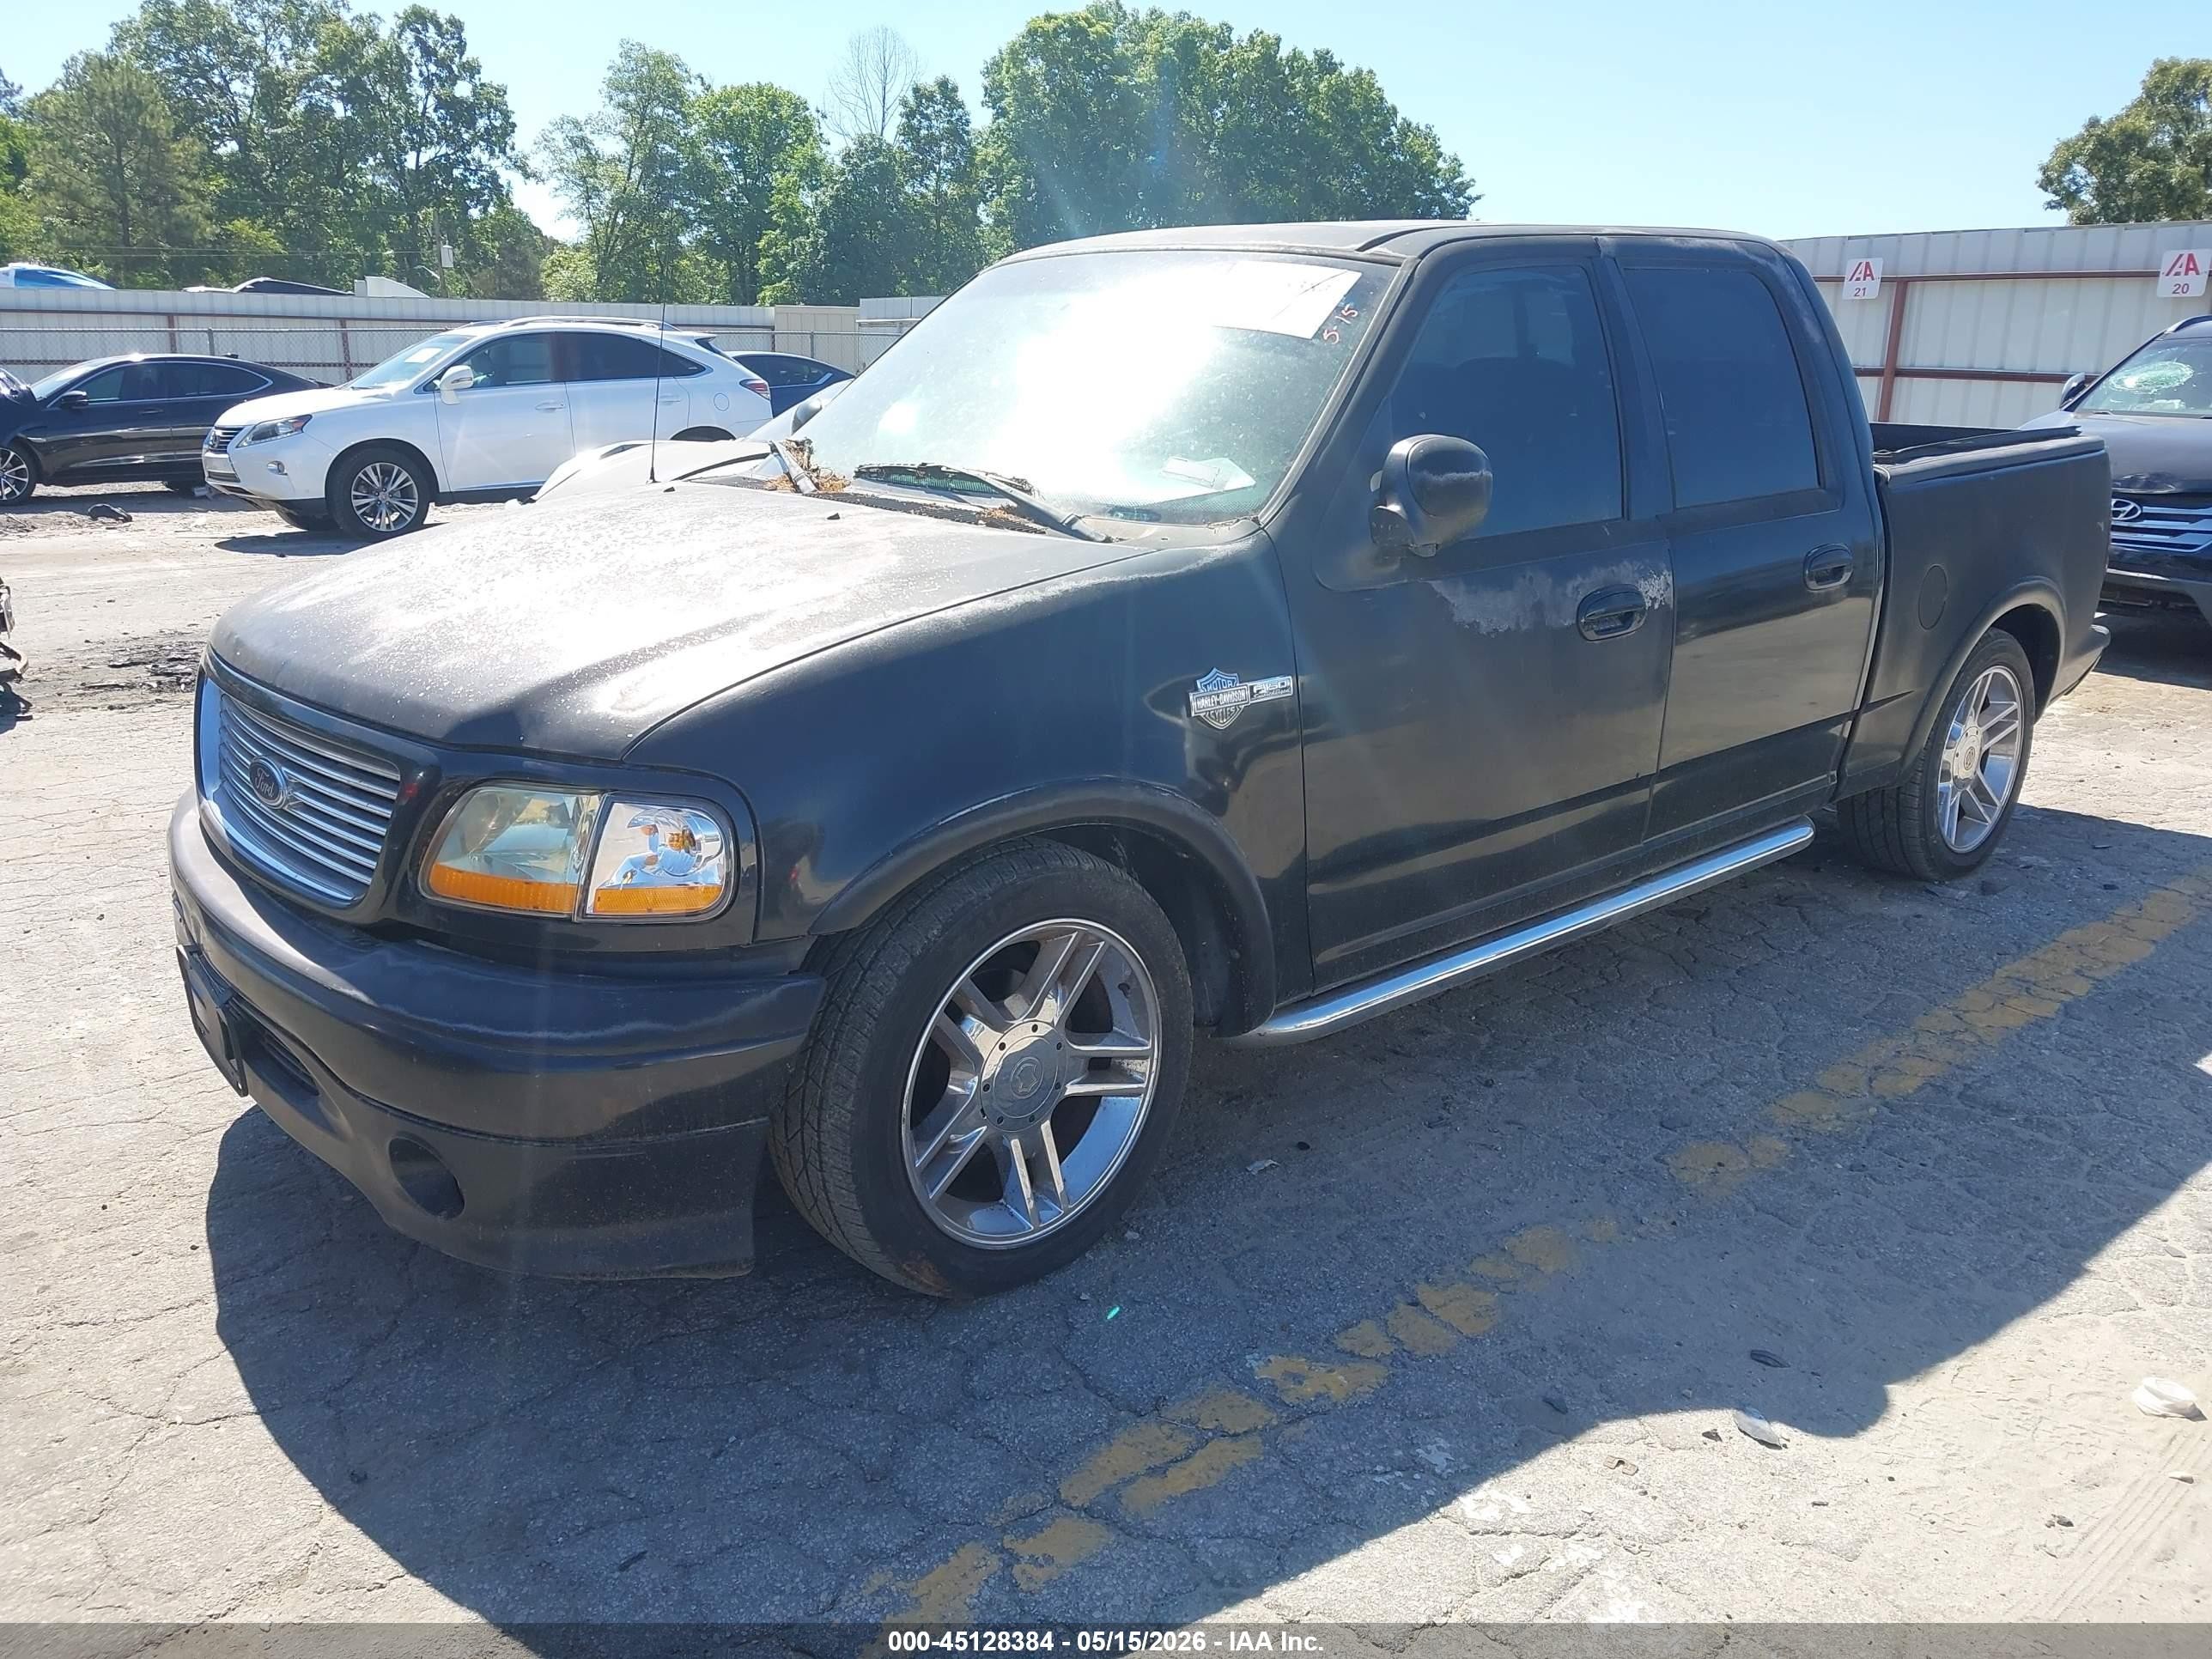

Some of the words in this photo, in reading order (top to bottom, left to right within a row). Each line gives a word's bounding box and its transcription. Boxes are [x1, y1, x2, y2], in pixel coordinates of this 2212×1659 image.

[1854, 287, 1867, 297] 21
[2172, 283, 2190, 295] 20
[1322, 304, 1358, 344] 5-15
[1202, 677, 1237, 692] MOTOR
[1196, 688, 1247, 709] HARLEY-DAVIDSON
[1206, 705, 1236, 722] CYCLES
[254, 768, 275, 798] Ford
